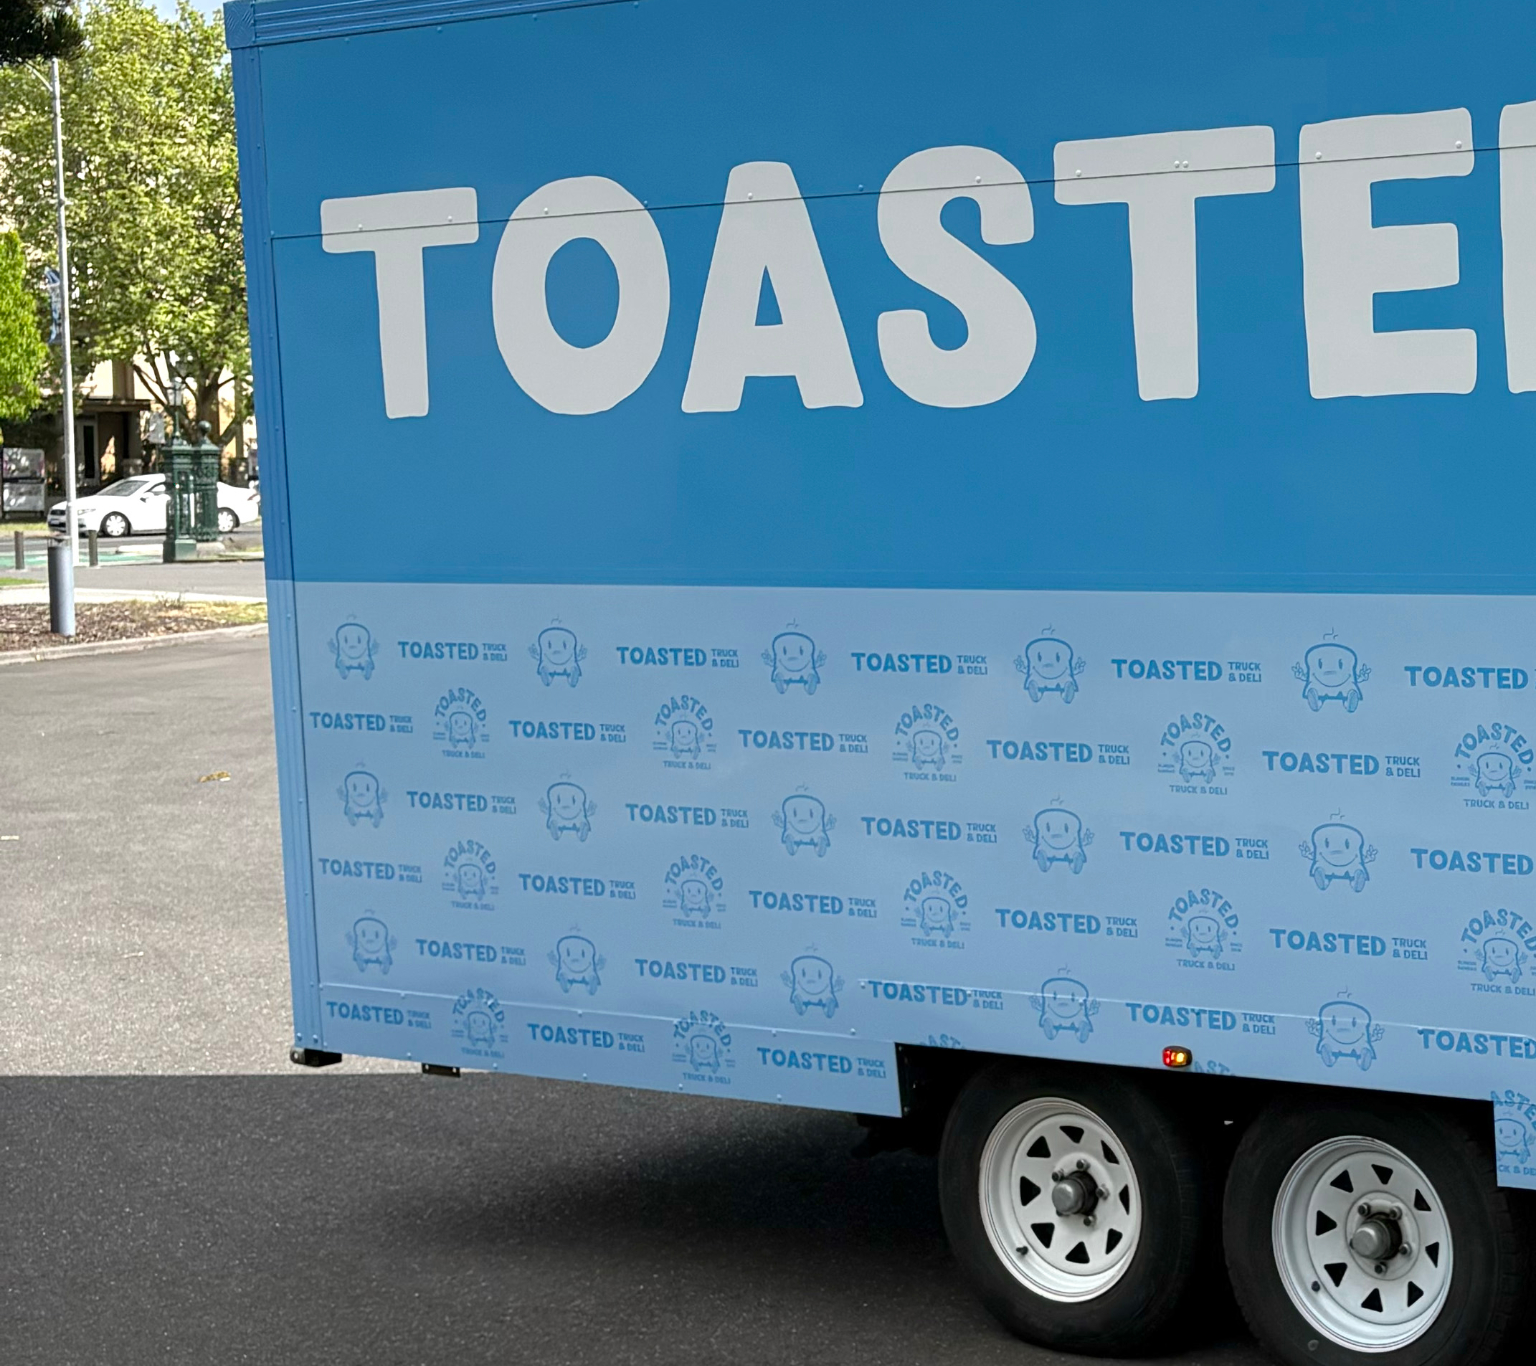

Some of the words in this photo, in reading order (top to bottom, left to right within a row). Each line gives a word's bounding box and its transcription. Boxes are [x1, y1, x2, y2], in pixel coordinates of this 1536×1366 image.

[398, 641, 478, 660] TOASTED
[616, 647, 706, 666] TOASTED
[851, 653, 952, 673] TOASTED
[1111, 659, 1222, 681] TOASTED
[1228, 661, 1261, 672] TRUCK
[1228, 672, 1236, 683] &
[1239, 673, 1261, 683] DELI
[1404, 666, 1528, 689] TOASTED
[435, 687, 486, 722] TOASTED
[655, 695, 713, 730] TOASTED
[310, 712, 386, 731] TOASTED
[509, 720, 595, 740] TOASTED
[895, 703, 959, 741] TOASTED
[1161, 712, 1231, 752] TOASTED
[738, 730, 834, 751] TOASTED
[987, 740, 1092, 762] TOASTED
[1455, 723, 1534, 764] TOASTED
[1262, 751, 1379, 775] TOASTED
[1385, 755, 1420, 767] TRUCK
[1386, 767, 1394, 777] &
[1397, 767, 1420, 779] DELI
[406, 791, 487, 812] TOASTED
[625, 804, 716, 825] TOASTED
[861, 817, 961, 840] TOASTED
[1120, 832, 1229, 856] TOASTED
[444, 840, 496, 874] TOASTED
[1411, 848, 1533, 875] TOASTED
[319, 858, 395, 881] TOASTED
[665, 854, 723, 890] TOASTED
[519, 874, 605, 896] TOASTED
[904, 871, 967, 909] TOASTED
[749, 891, 843, 914] TOASTED
[1168, 889, 1239, 929] TOASTED
[995, 909, 1100, 934] TOASTED
[416, 939, 497, 962] TOASTED
[1270, 929, 1386, 956] TOASTED
[1392, 937, 1426, 950] TRUCK
[1393, 948, 1401, 959] &
[1404, 949, 1427, 961] DELI
[635, 959, 726, 983] TOASTED
[452, 987, 505, 1022] TOASTED
[868, 981, 970, 1006] TOASTED
[326, 1001, 404, 1025] TOASTED
[1125, 1003, 1236, 1030] TOASTED
[527, 1023, 614, 1048] TOASTED
[673, 1010, 731, 1046] TOASTED
[757, 1047, 852, 1073] TOASTED
